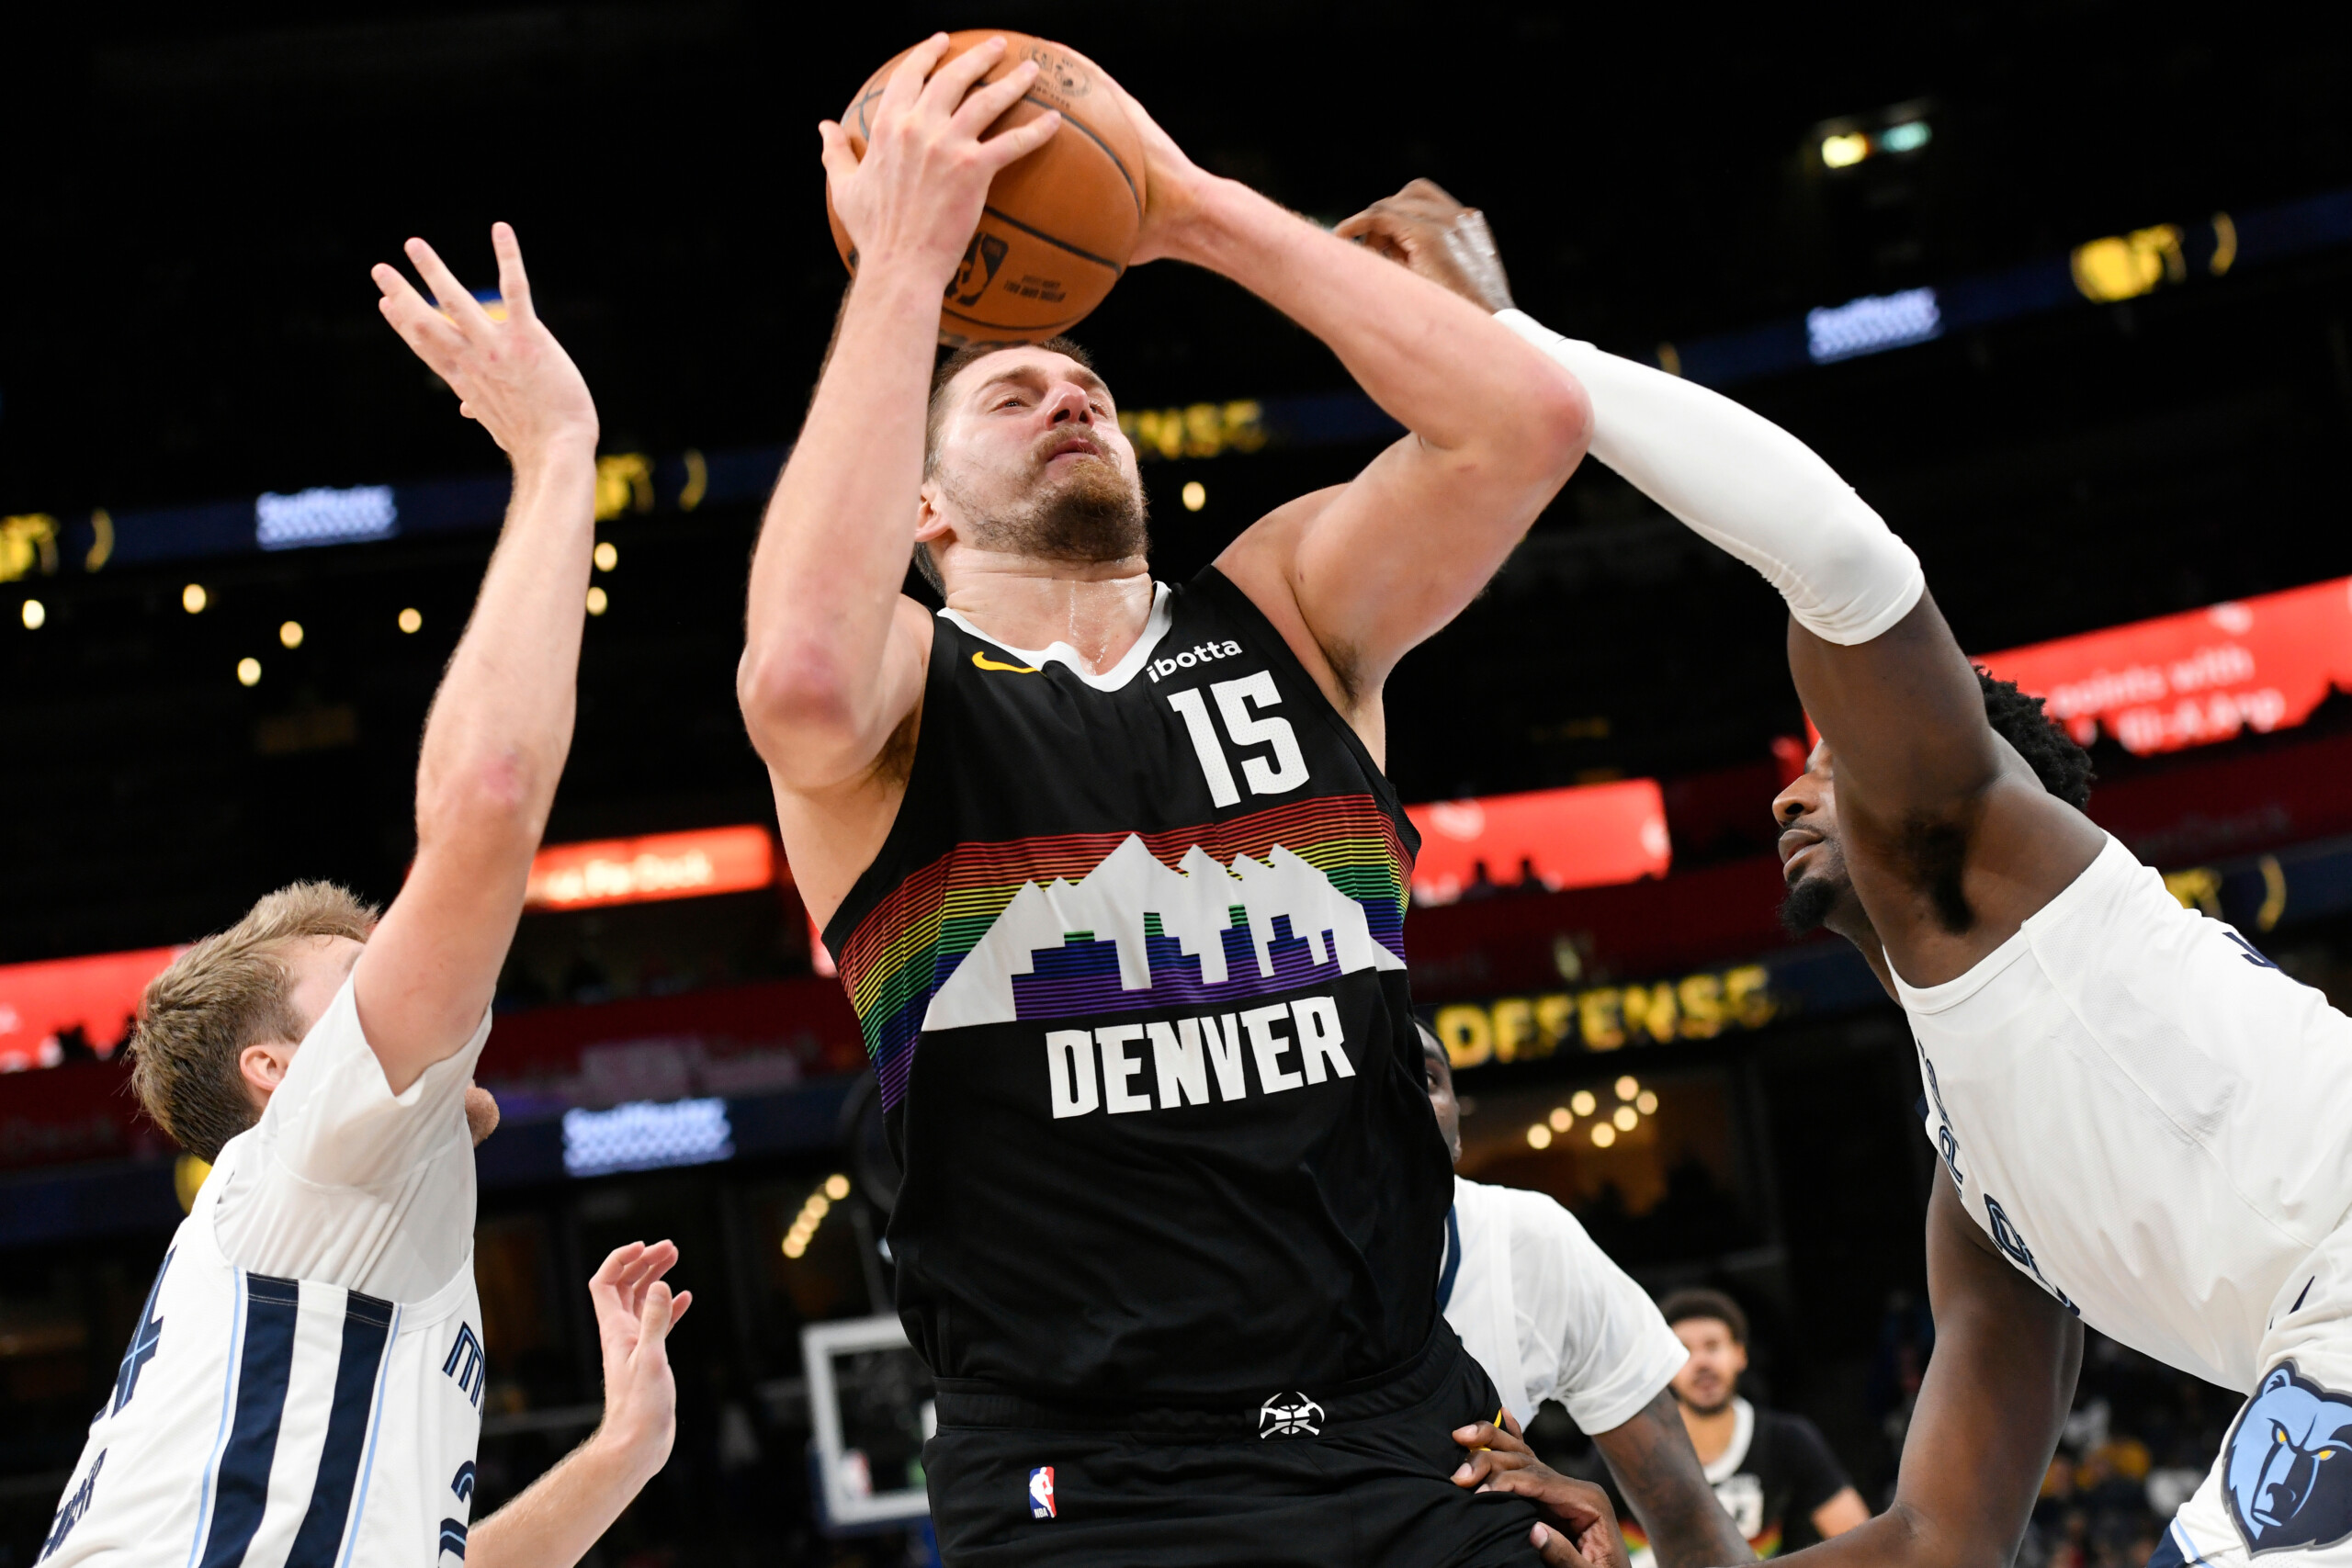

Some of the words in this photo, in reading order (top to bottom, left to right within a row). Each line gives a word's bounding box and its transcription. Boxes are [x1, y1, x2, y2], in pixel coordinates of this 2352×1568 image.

[1147, 640, 1243, 683] ibotta
[1167, 670, 1310, 808] 15
[1046, 996, 1356, 1119] DENVER
[1034, 1506, 1048, 1518] NBA
